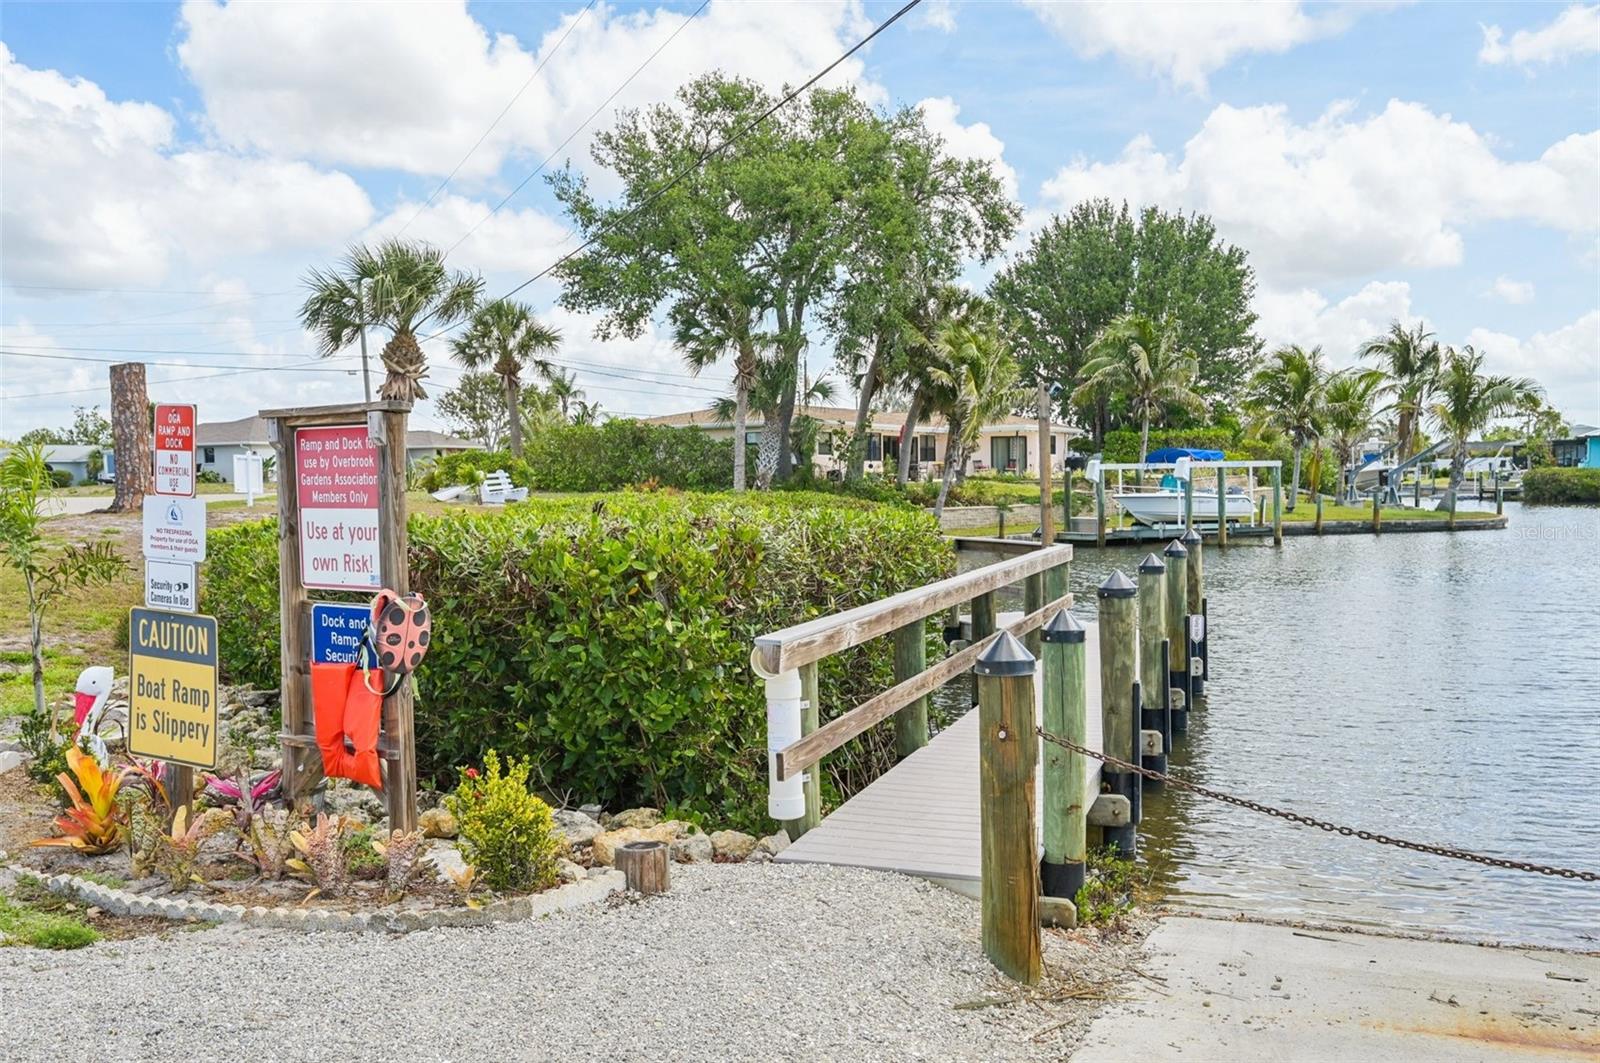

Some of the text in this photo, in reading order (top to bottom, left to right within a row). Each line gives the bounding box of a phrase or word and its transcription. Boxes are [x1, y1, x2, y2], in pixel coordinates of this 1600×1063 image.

[168, 413, 181, 423] OGA
[158, 426, 190, 436] RAMP AND
[165, 438, 183, 448] DOCK
[300, 438, 322, 453] Ramp
[325, 438, 339, 450] and
[342, 437, 363, 449] Dock
[170, 454, 178, 464] NO
[304, 455, 374, 470] use by Overbrook
[158, 465, 190, 477] COMMERCIAL
[169, 478, 179, 487] USE
[301, 473, 332, 485] Gardens
[312, 489, 368, 505] Members Only
[307, 521, 377, 544] Use at your
[313, 554, 373, 572] own Risk!
[151, 578, 172, 593] Security
[151, 591, 189, 606] Cameras In Use
[322, 614, 366, 628] Dock and
[139, 618, 208, 655] CAUTION
[331, 631, 359, 649] Ramp
[138, 674, 209, 712] Boat Ramp
[136, 707, 209, 747] is Slippery
